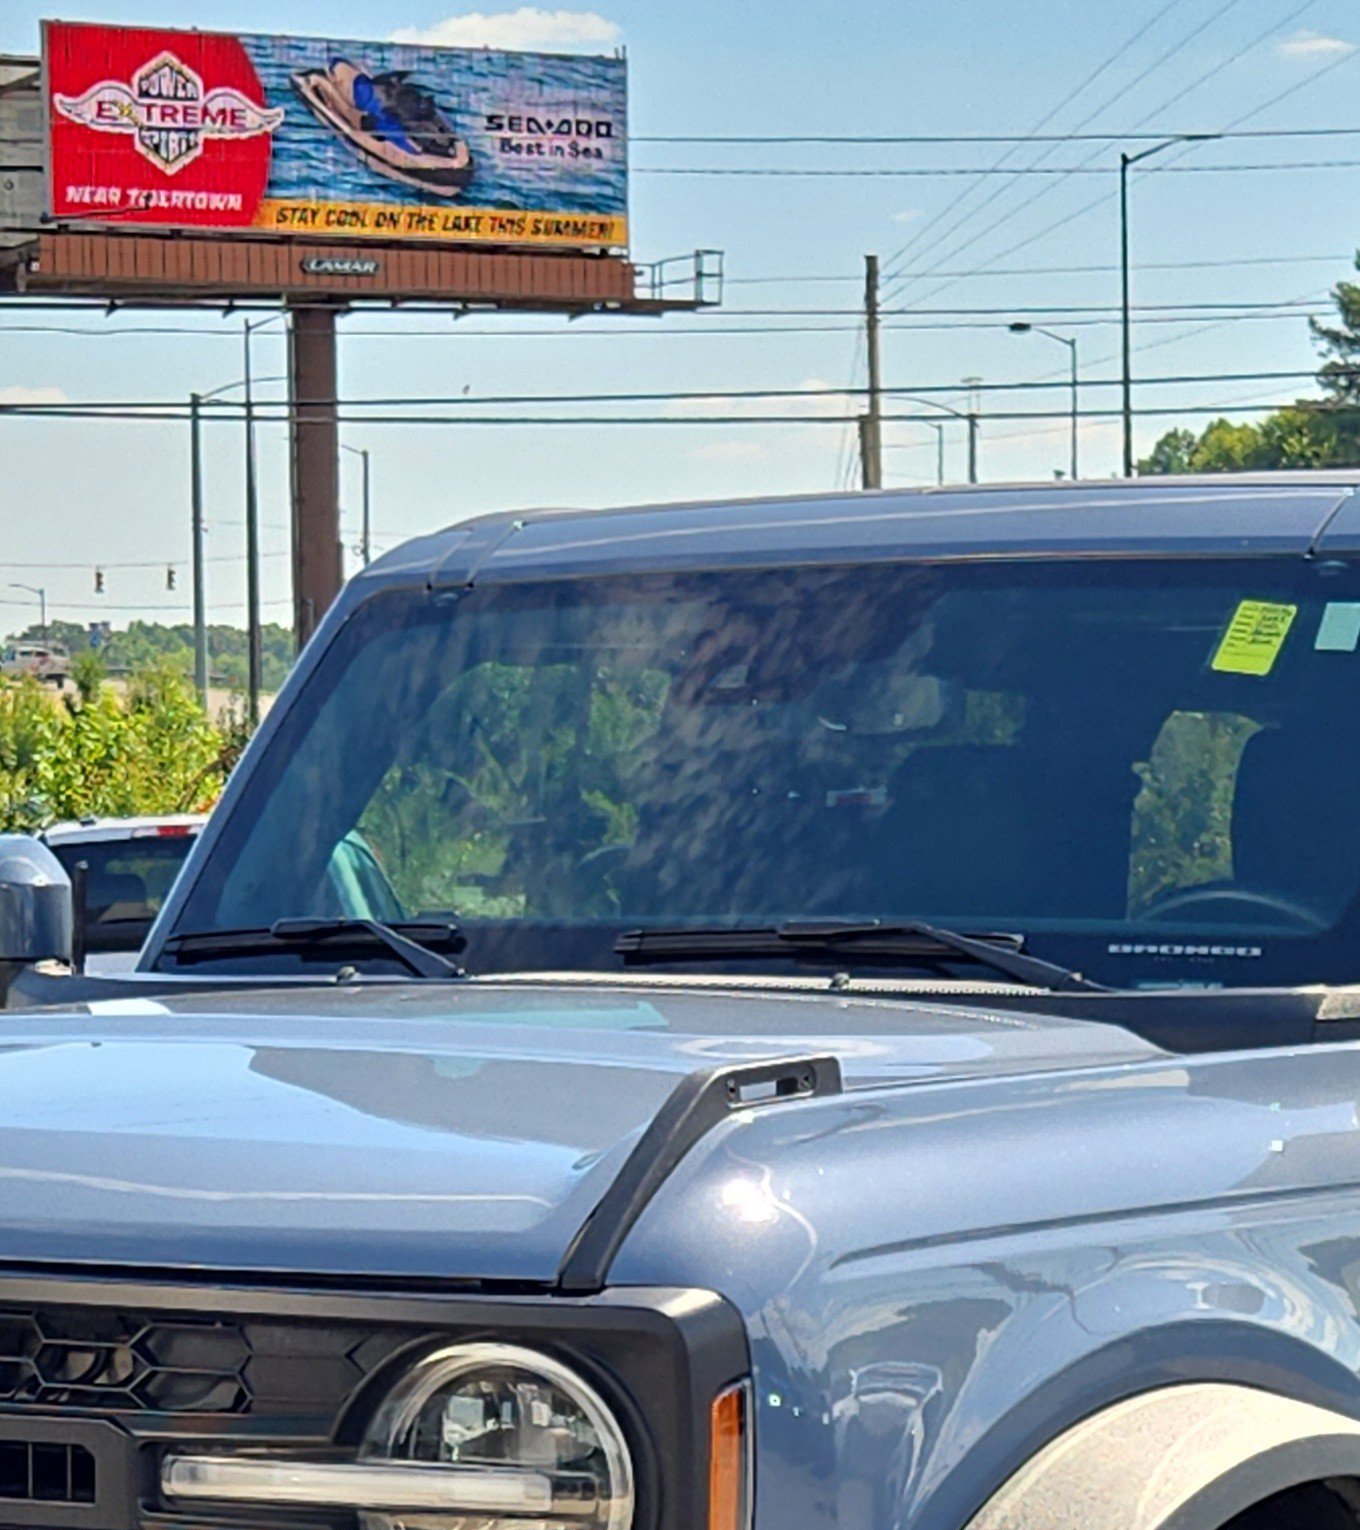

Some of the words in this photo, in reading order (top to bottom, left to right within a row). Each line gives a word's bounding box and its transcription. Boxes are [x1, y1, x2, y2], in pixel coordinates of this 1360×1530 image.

[140, 66, 199, 98] POWER
[96, 99, 247, 128] EXTREME
[500, 137, 545, 156] Best
[549, 143, 565, 157] in
[568, 140, 603, 159] Sea
[66, 185, 122, 206] NEAR
[276, 206, 321, 225] STAY
[324, 208, 368, 228] COOL
[374, 211, 402, 229] ON
[406, 212, 439, 232] THE
[441, 214, 483, 234] LAKE
[489, 216, 526, 236] THIS
[309, 258, 377, 274] LAMAR
[1108, 943, 1263, 957] BRONCO
